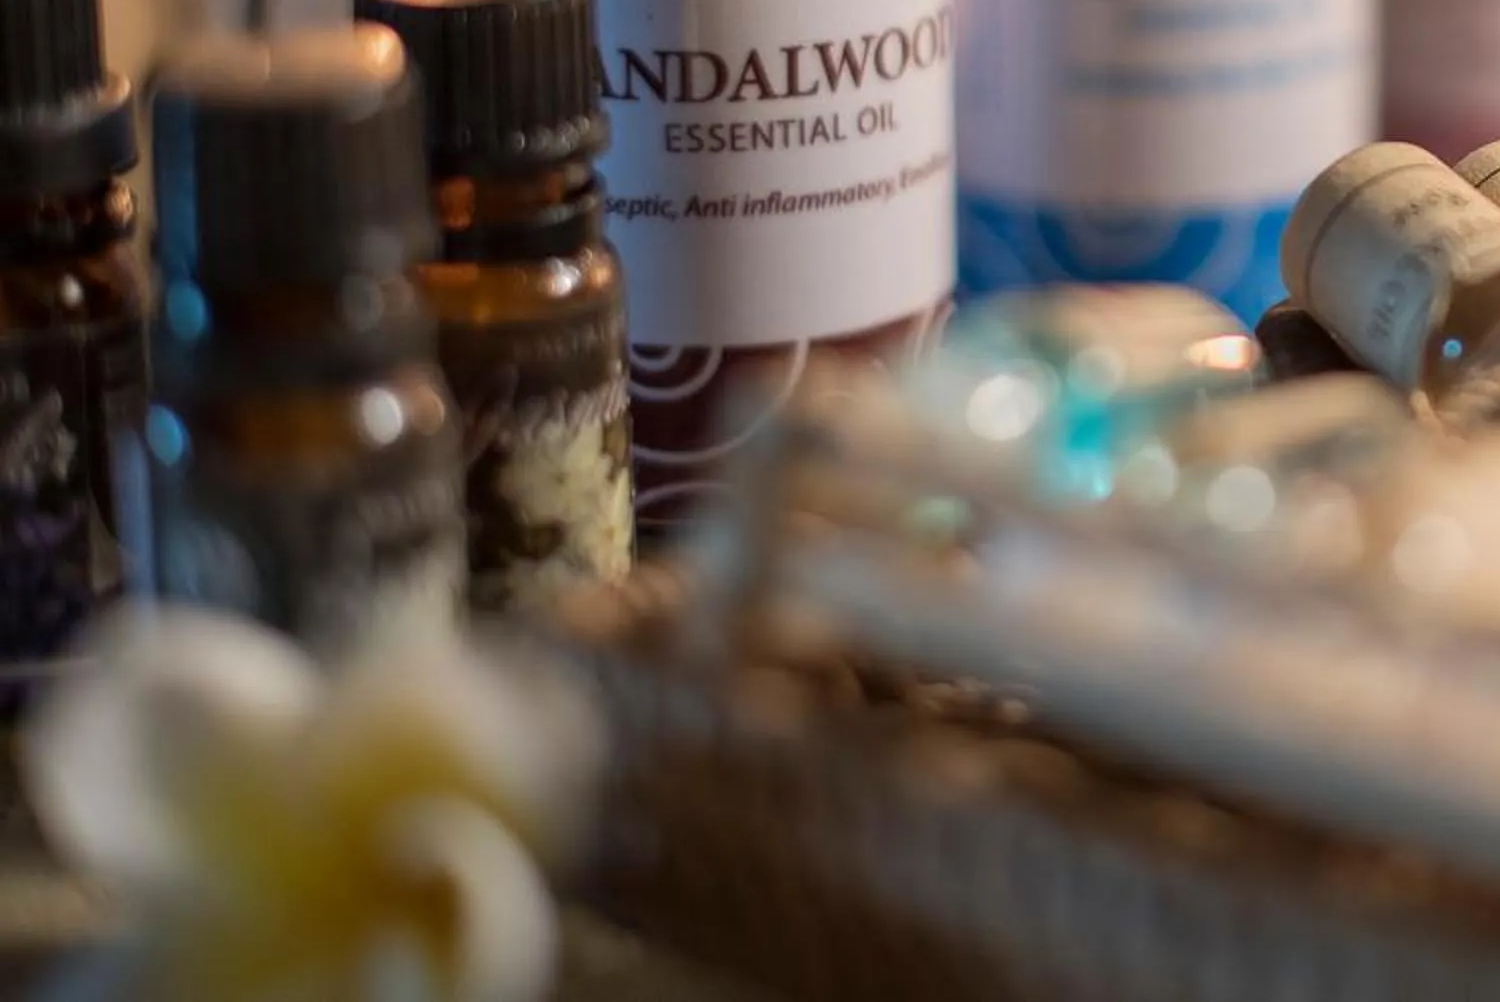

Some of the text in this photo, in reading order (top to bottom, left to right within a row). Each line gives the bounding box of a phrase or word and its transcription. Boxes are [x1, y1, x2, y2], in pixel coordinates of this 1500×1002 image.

[596, 4, 956, 104] NDALWOO
[664, 102, 900, 154] ESSENTIAL OIL
[604, 195, 680, 222] septic,
[684, 195, 736, 220] Anti
